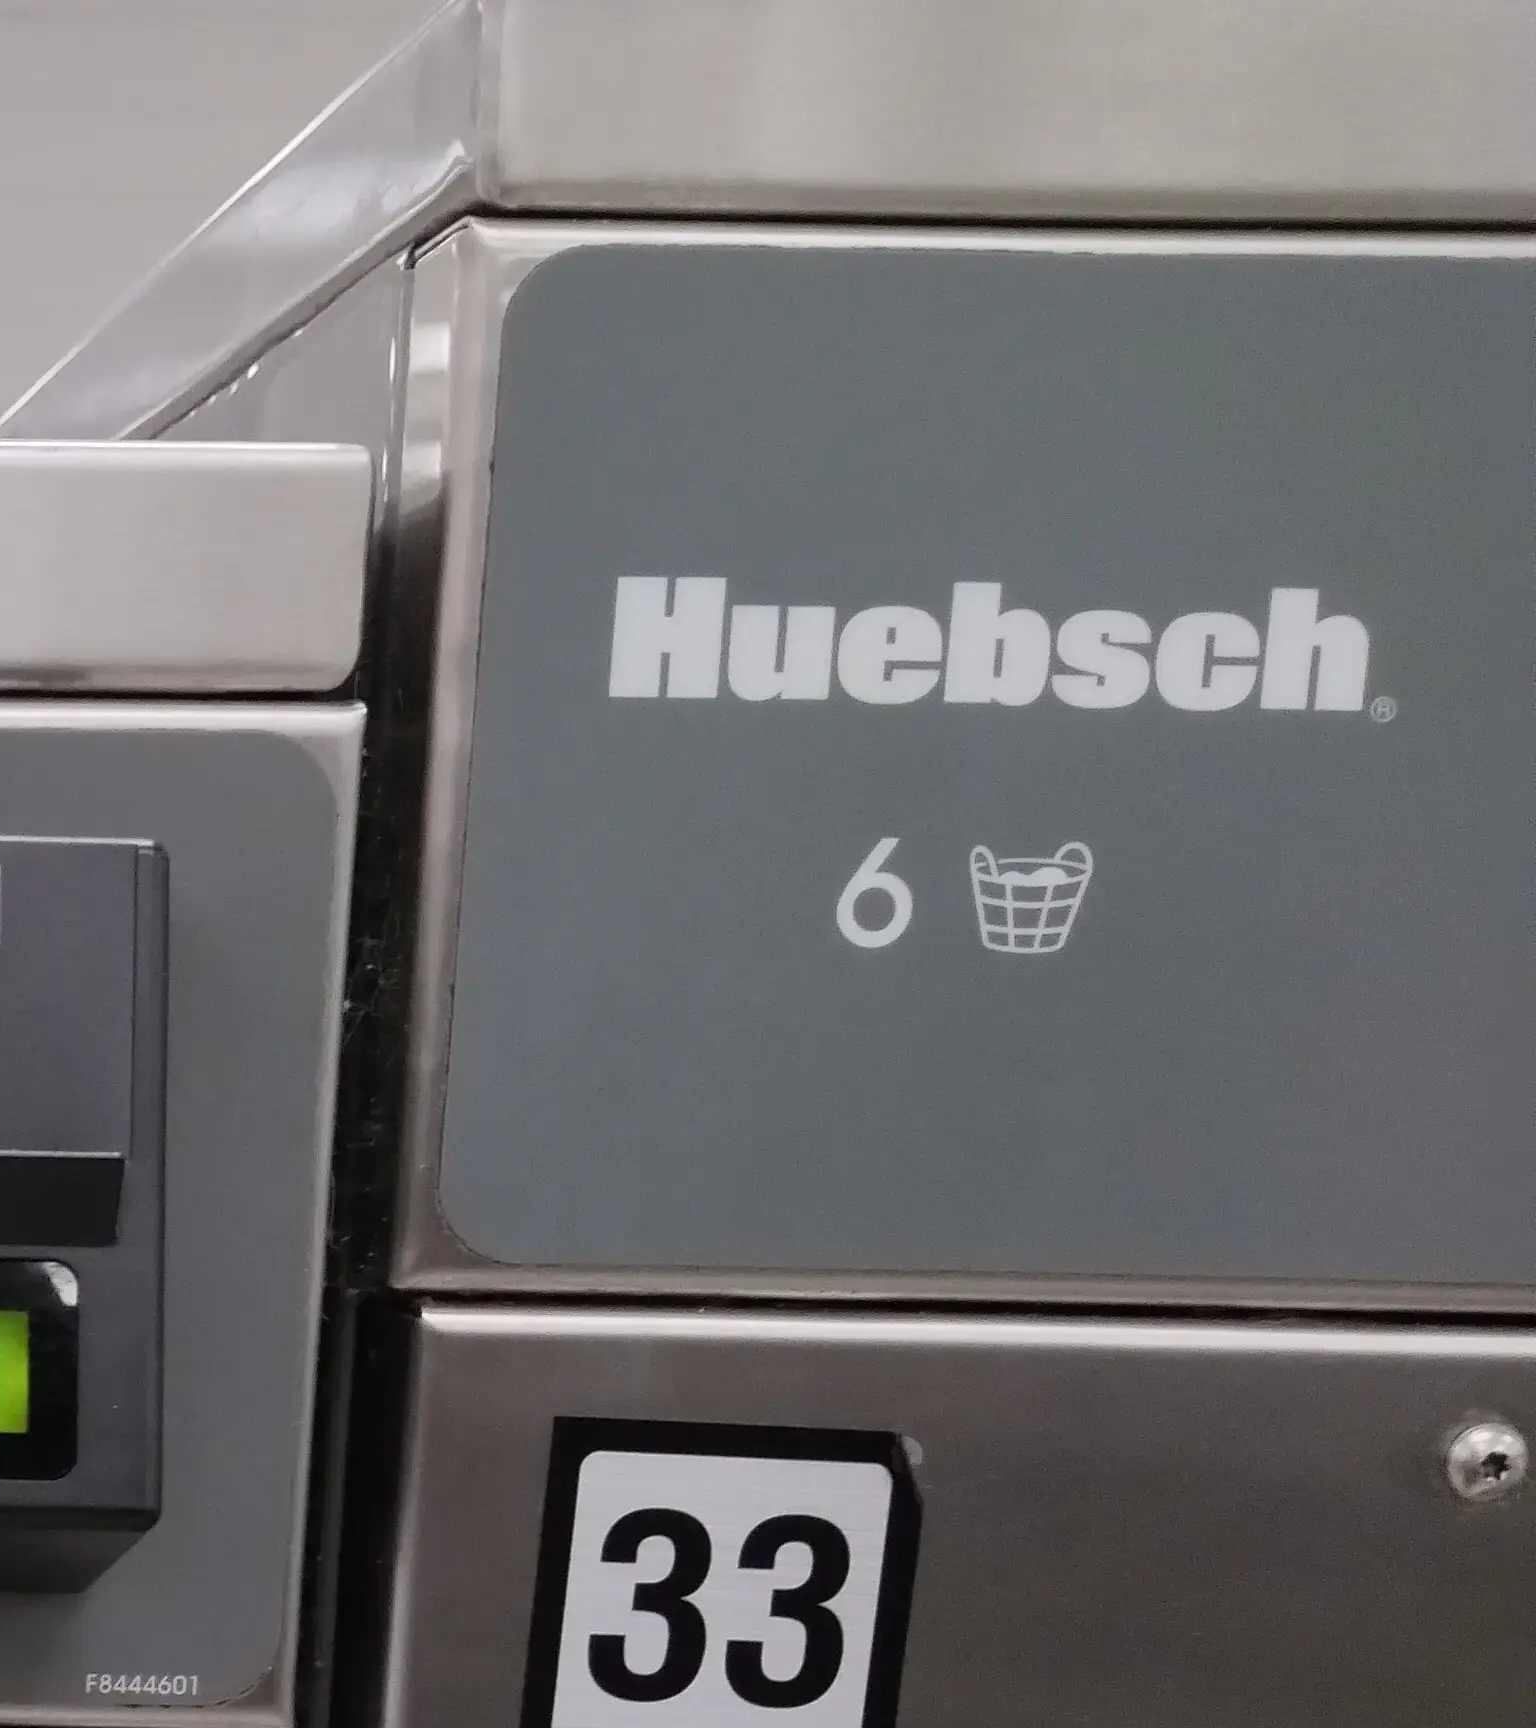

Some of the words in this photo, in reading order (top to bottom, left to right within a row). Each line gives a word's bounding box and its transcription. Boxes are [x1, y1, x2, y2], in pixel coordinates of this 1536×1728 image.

[835, 837, 914, 949] 6
[587, 1507, 851, 1710] 33
[84, 1672, 201, 1696] F8444601
